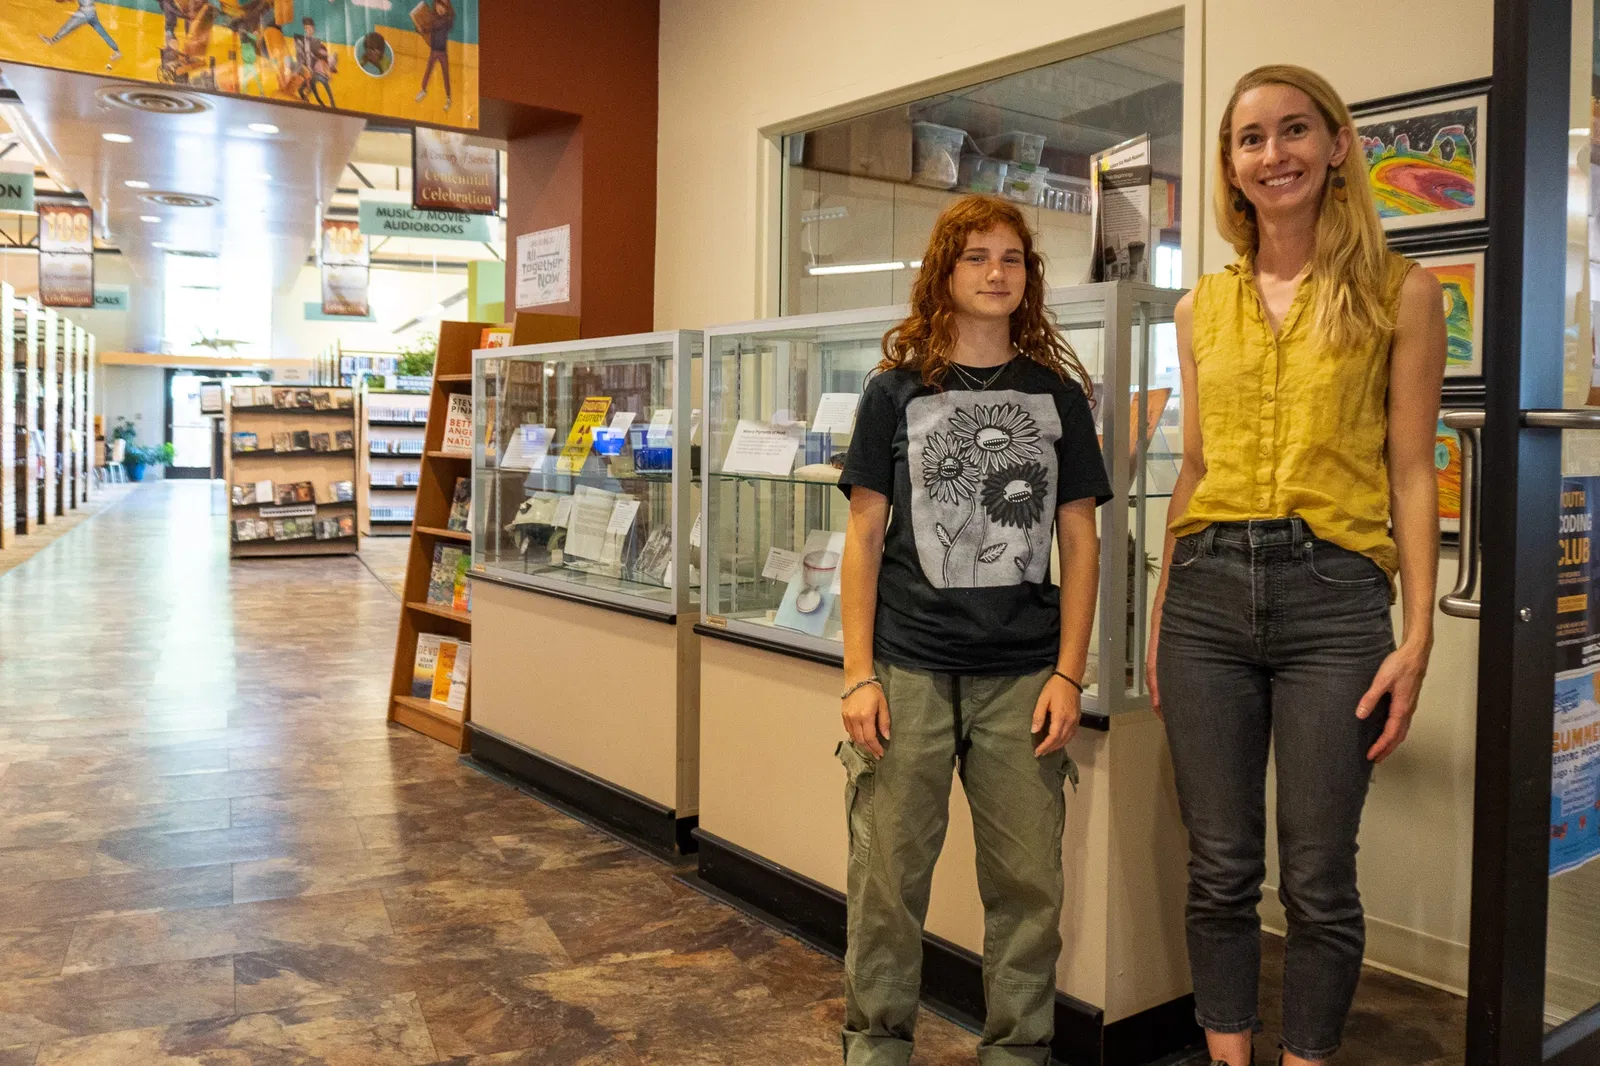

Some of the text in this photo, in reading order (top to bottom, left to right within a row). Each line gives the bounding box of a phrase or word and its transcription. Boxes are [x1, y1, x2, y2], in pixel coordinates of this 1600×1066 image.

[424, 169, 489, 186] Centennial
[422, 187, 492, 205] Celebration
[376, 207, 414, 219] MUSIC
[383, 219, 464, 234] AUDIOBOOKS
[522, 258, 563, 275] Together
[537, 272, 560, 288] Now
